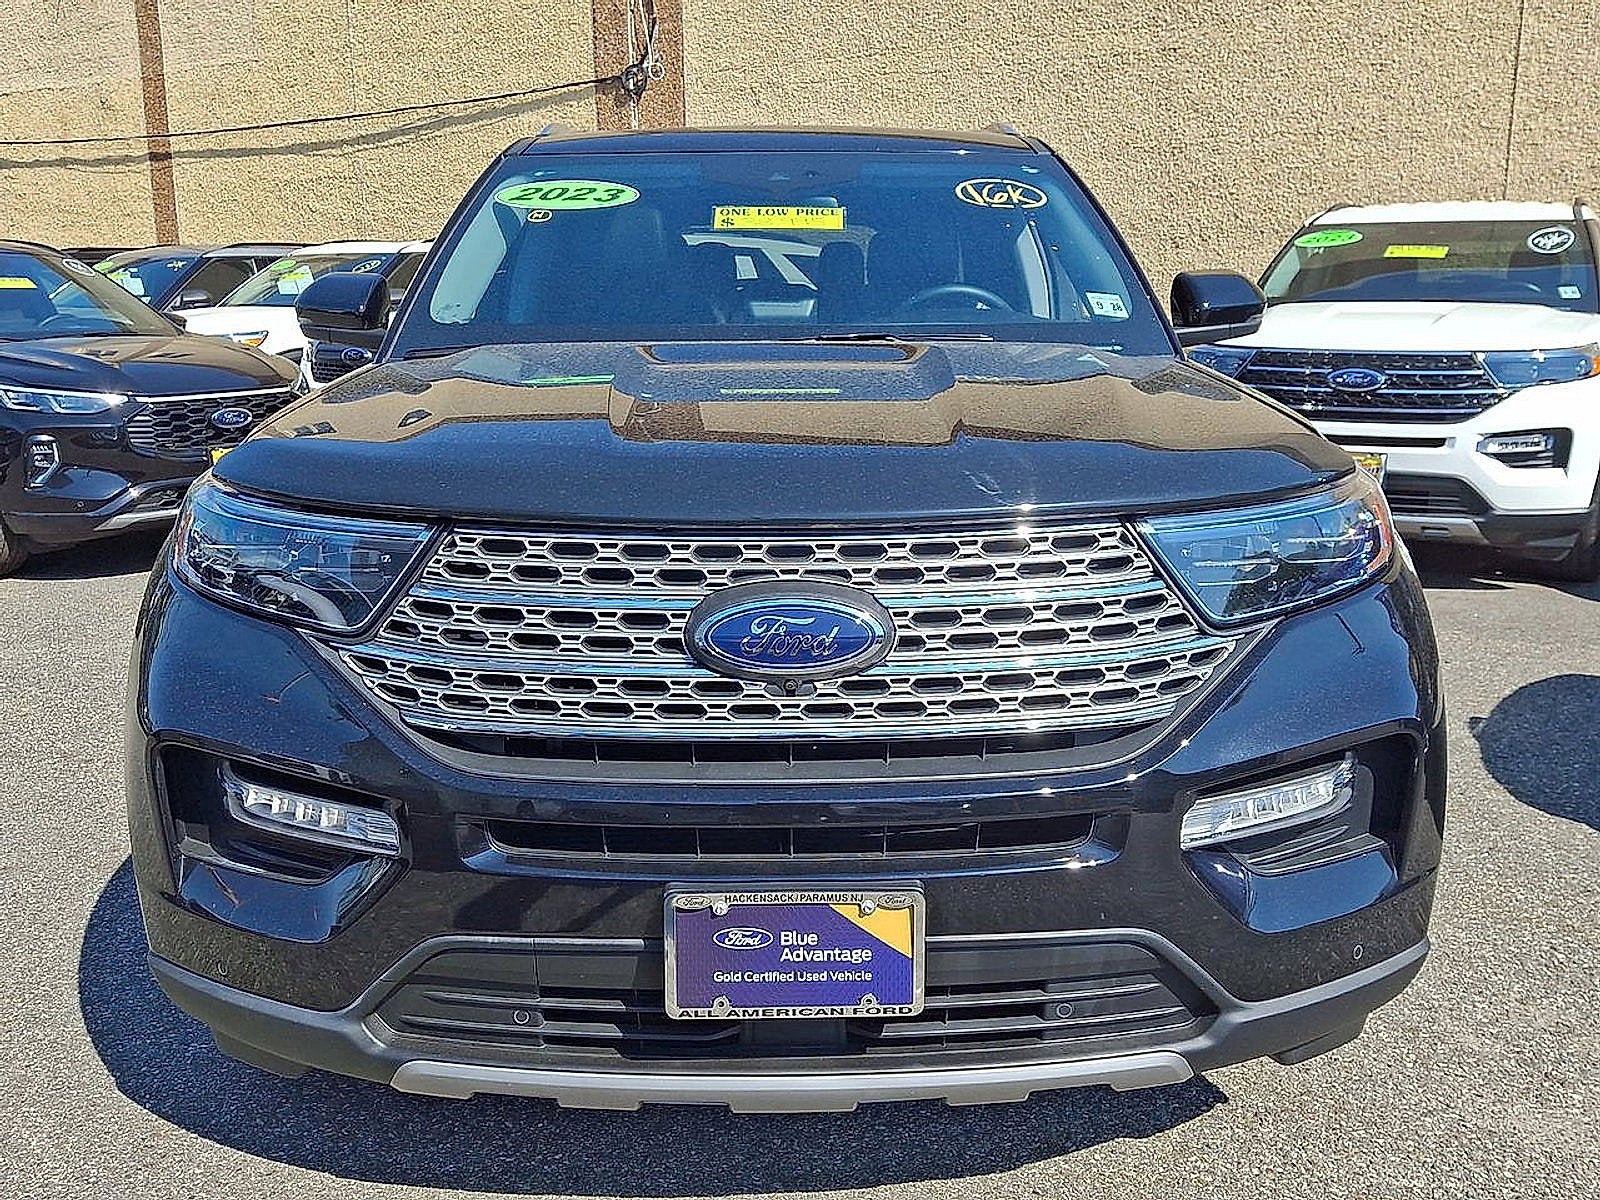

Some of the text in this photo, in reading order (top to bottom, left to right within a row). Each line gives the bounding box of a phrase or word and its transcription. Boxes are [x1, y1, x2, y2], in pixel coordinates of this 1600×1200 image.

[508, 187, 626, 203] 2023
[719, 208, 840, 217] ONE LOW PRICE
[741, 615, 839, 657] Ford
[850, 893, 864, 903] NJ
[724, 929, 762, 946] Ford
[780, 931, 819, 946] Blue
[780, 947, 873, 964] Advantage
[713, 971, 873, 983] Gold Certified Used Vehicle
[678, 1006, 914, 1019] ALL AMERICAN FORD
